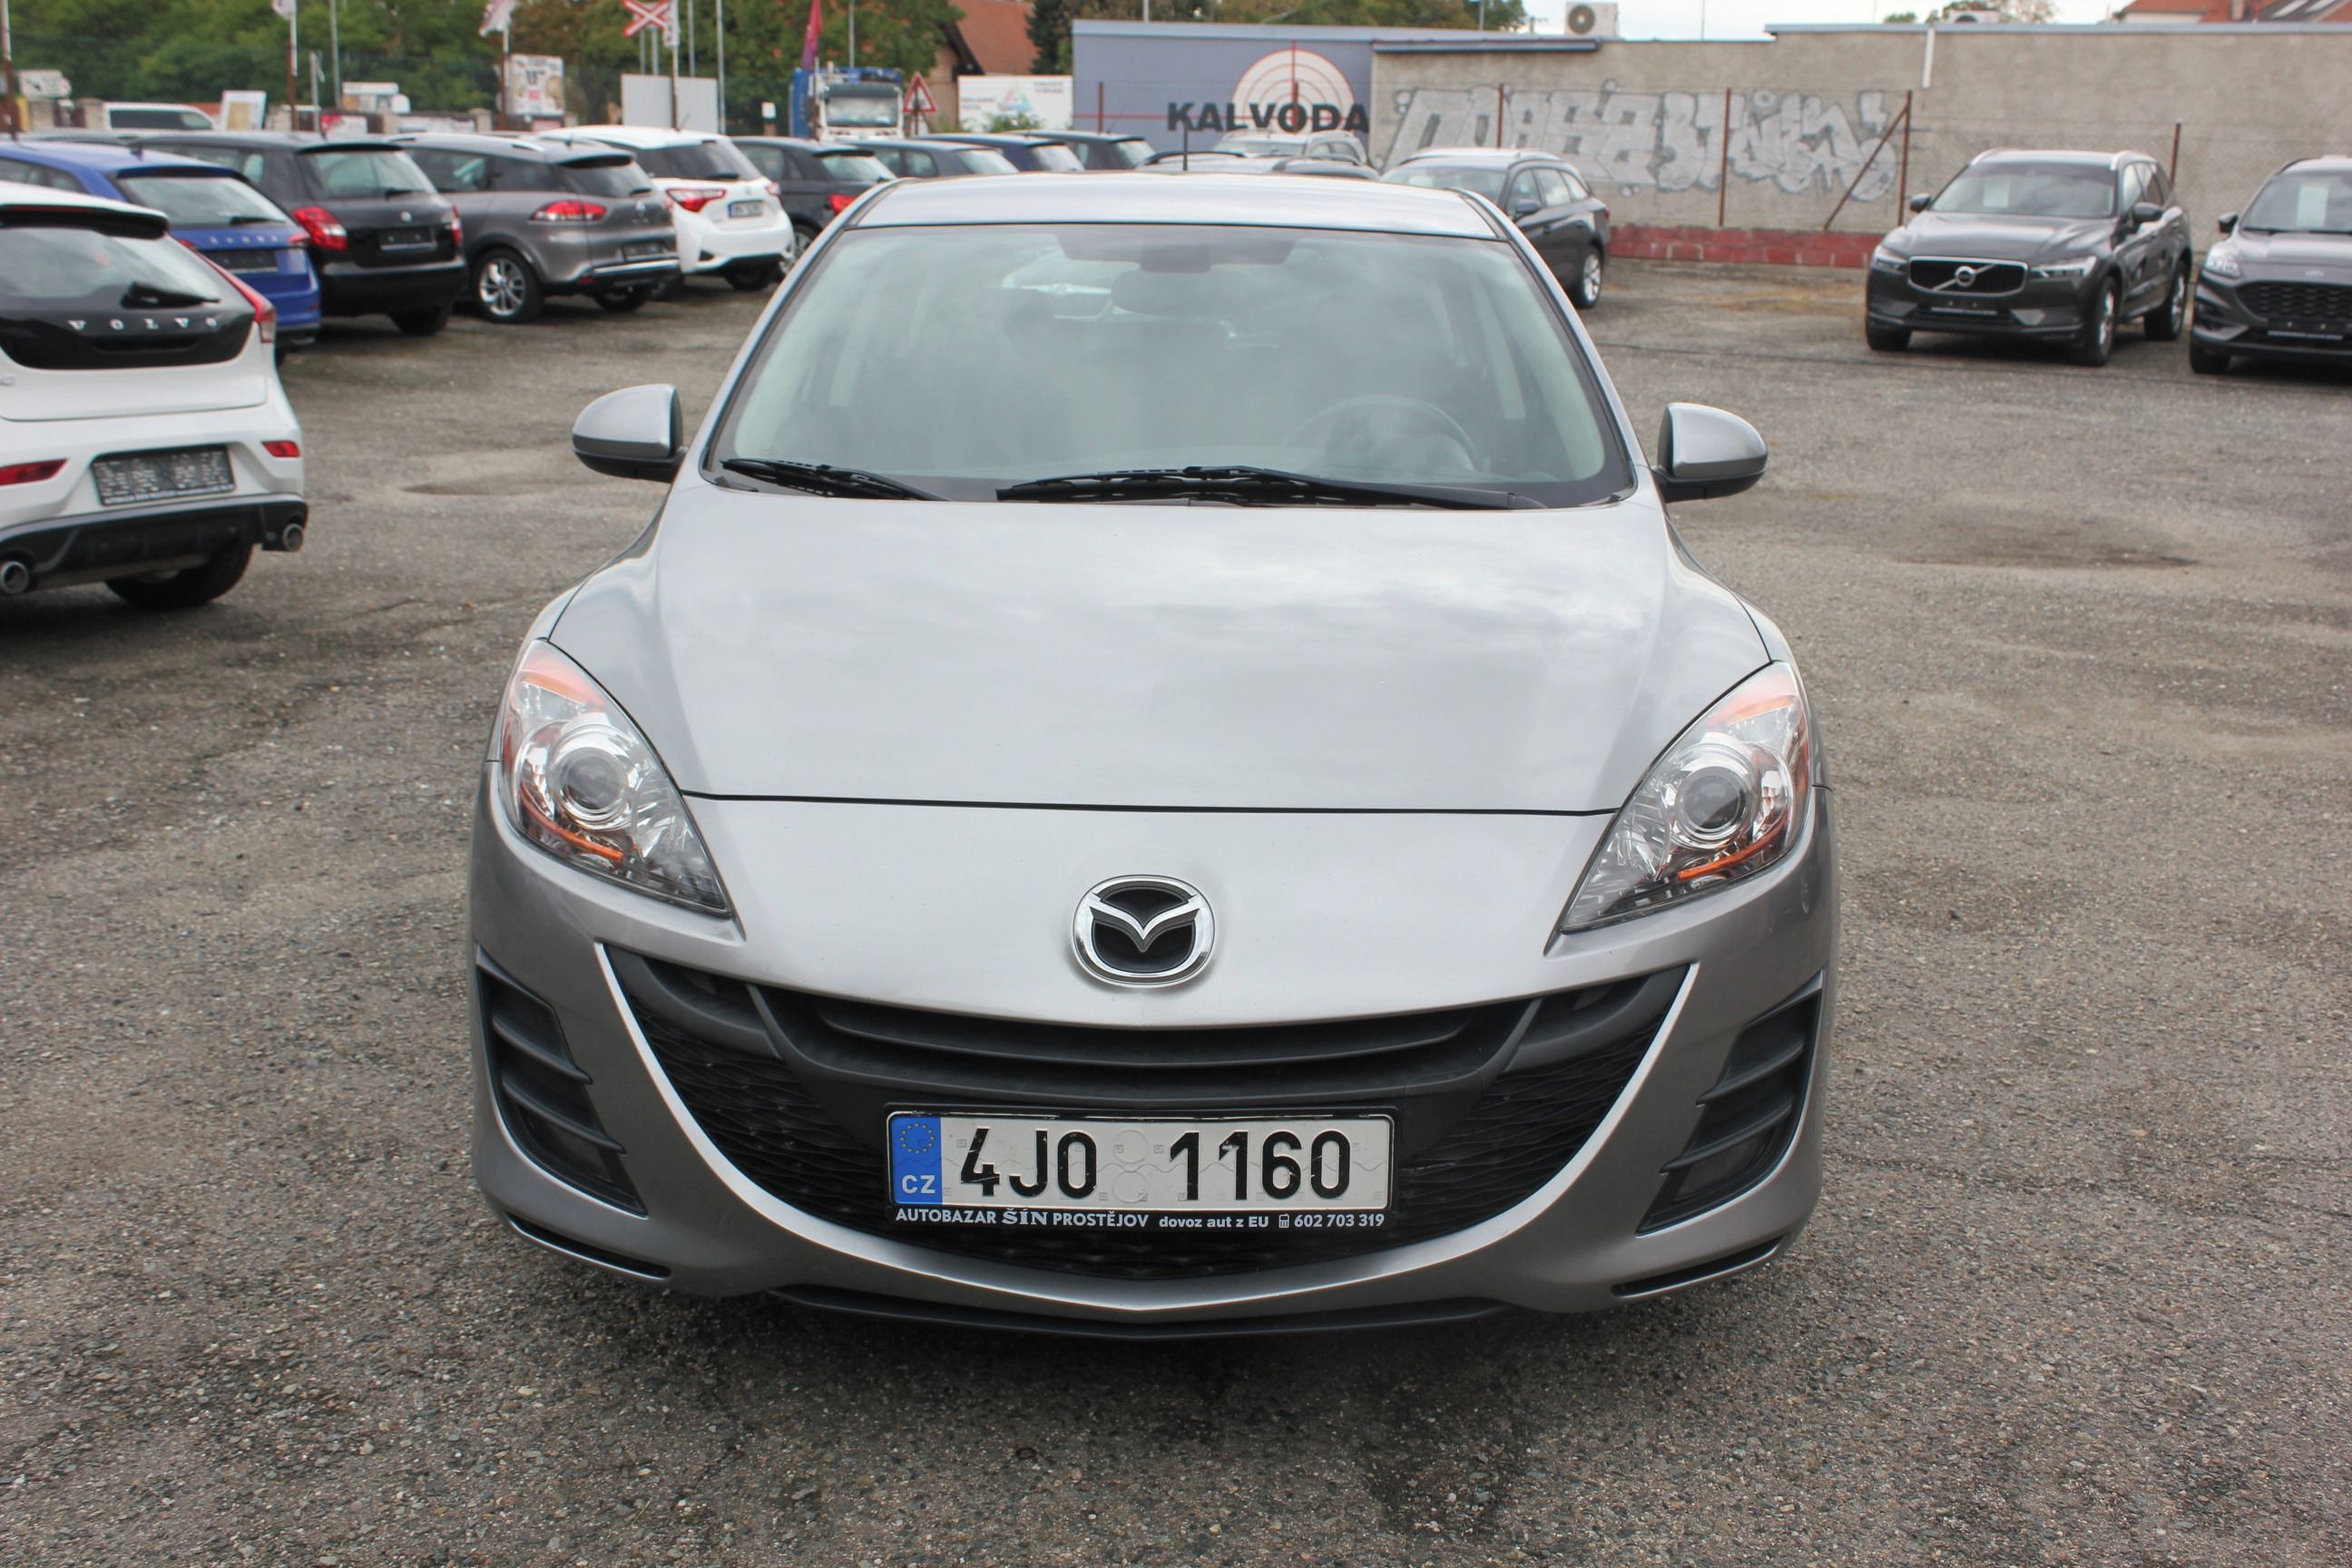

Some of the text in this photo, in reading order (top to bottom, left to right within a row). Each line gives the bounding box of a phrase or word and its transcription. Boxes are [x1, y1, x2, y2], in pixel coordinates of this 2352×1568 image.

[1167, 102, 1370, 132] KALVODA
[67, 317, 218, 331] VOLVO
[960, 1127, 1351, 1200] 4J0 1160
[901, 1174, 936, 1195] CZ
[896, 1208, 1385, 1229] AUTOBAZAR ŠÍN PROSTĚJOV dovoz aut z EU 602 703 319
